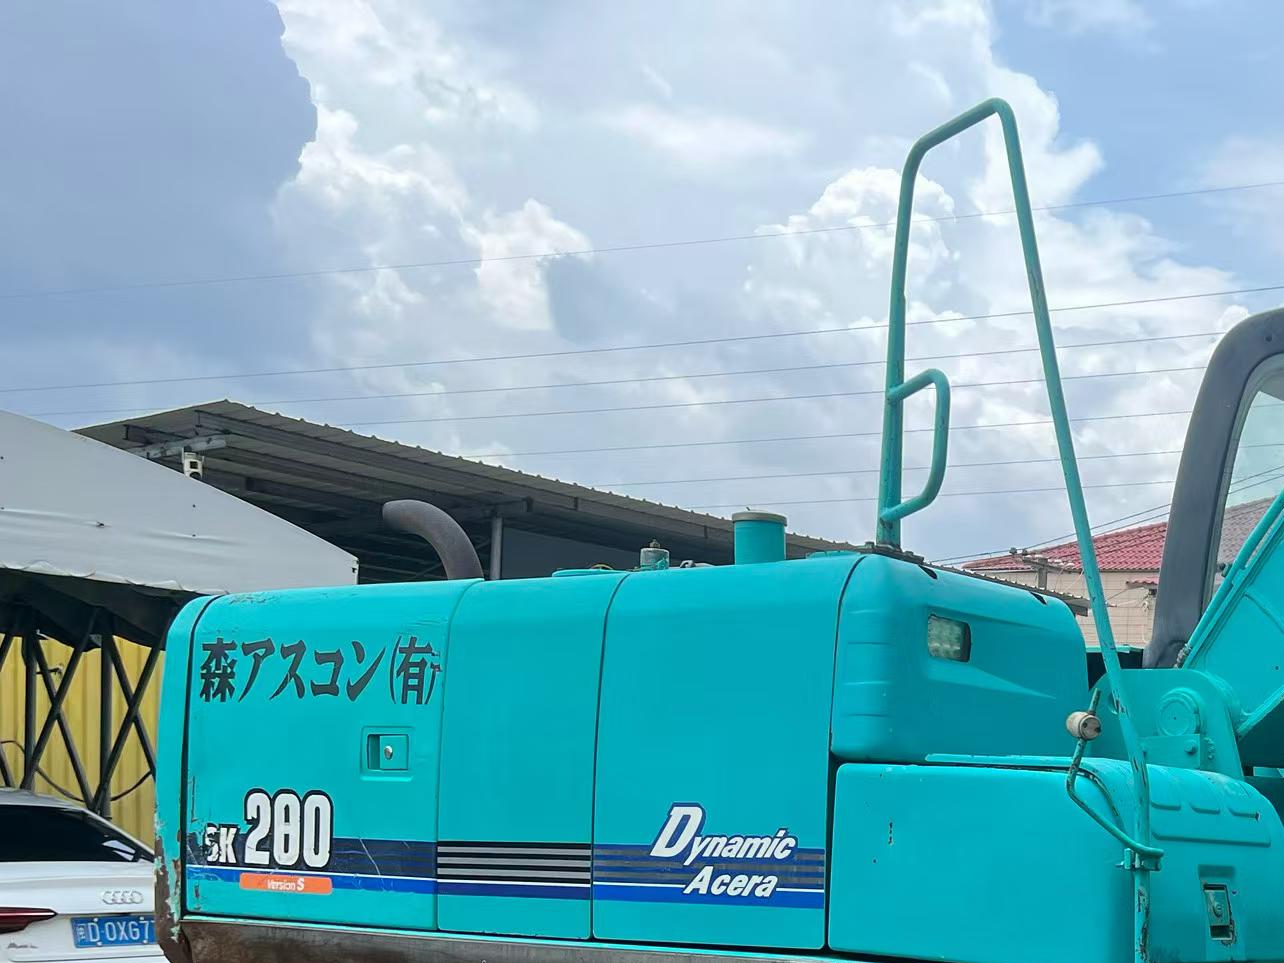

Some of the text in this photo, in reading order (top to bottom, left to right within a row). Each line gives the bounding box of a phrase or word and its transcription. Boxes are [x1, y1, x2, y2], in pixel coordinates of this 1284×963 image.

[244, 791, 332, 868] 280
[650, 805, 797, 866] Dynamic
[267, 878, 296, 891] Version
[683, 865, 778, 898] Acera
